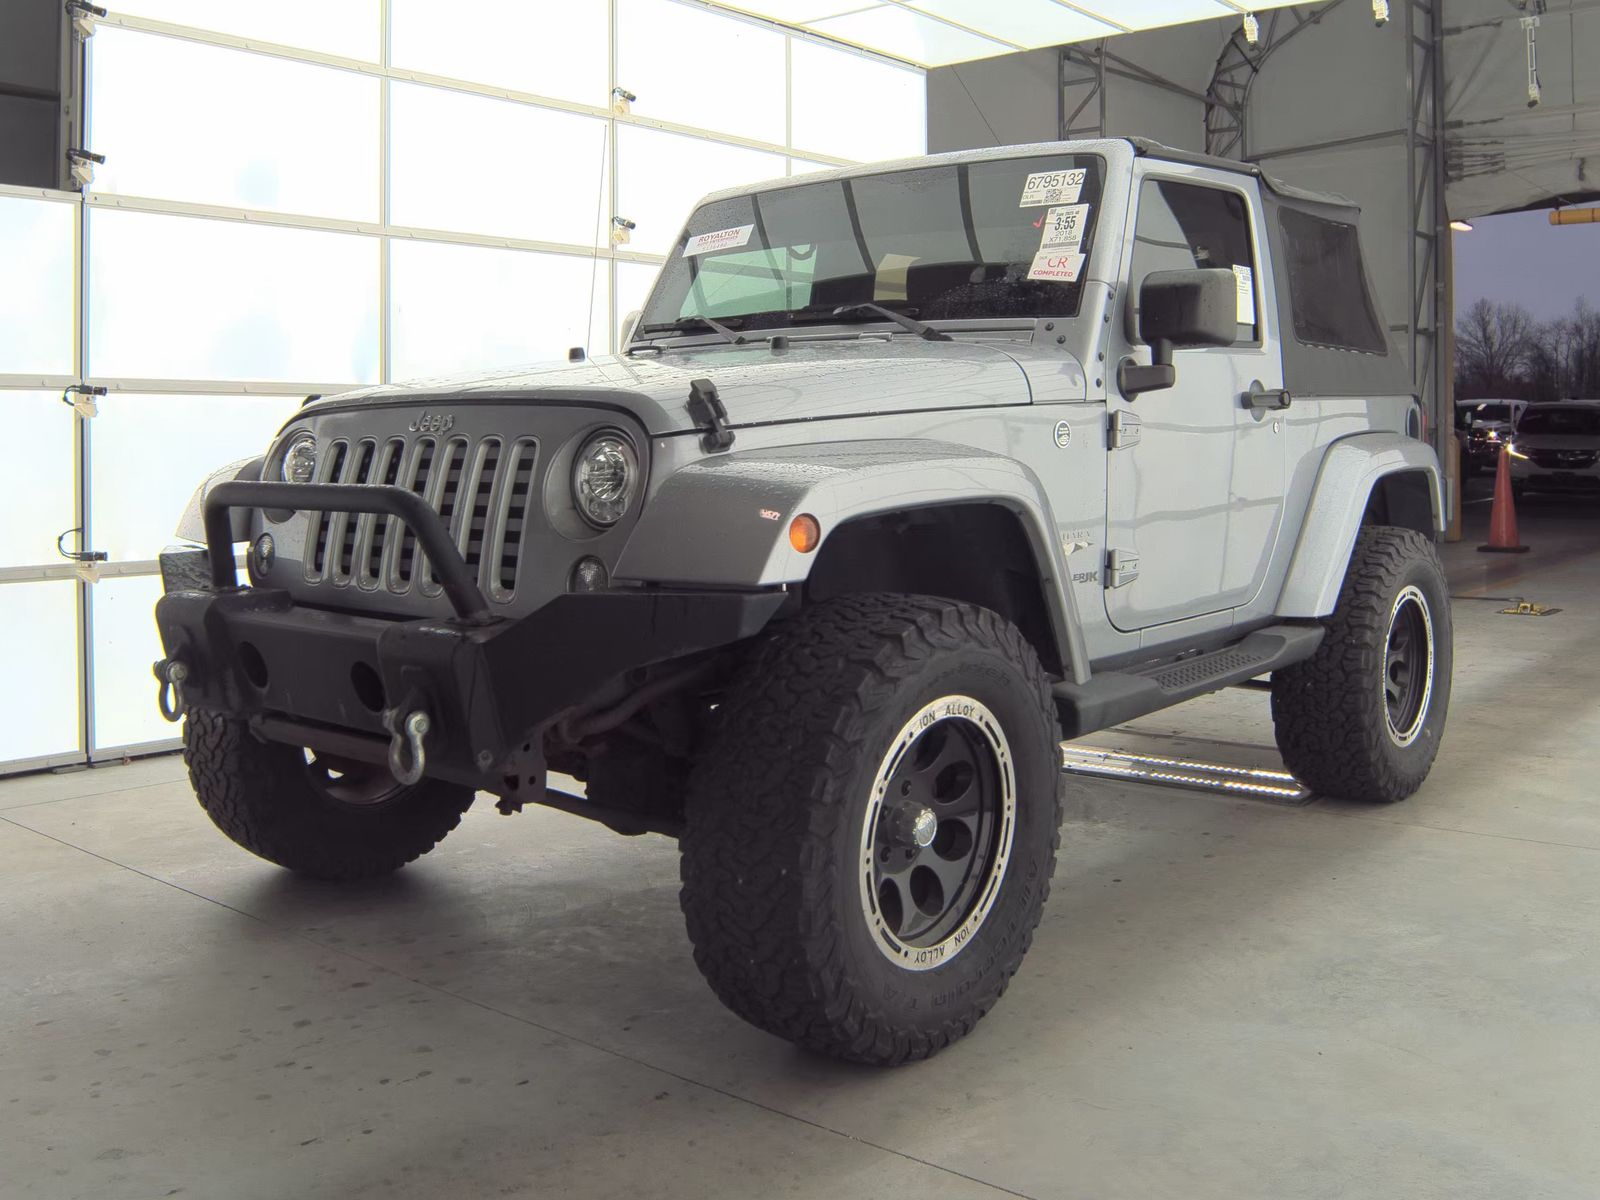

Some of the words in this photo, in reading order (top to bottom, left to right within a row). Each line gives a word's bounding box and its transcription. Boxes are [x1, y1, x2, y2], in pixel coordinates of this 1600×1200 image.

[1028, 172, 1084, 190] 6795132
[1054, 215, 1077, 231] 3:55
[699, 229, 740, 242] ROYALTON
[1047, 257, 1068, 268] CR
[1033, 269, 1074, 278] COMPLETED
[408, 409, 455, 436] Jeep
[919, 710, 936, 729] ION
[945, 703, 975, 717] ALLOY
[953, 926, 970, 946] ION
[914, 944, 945, 964] ALLOY
